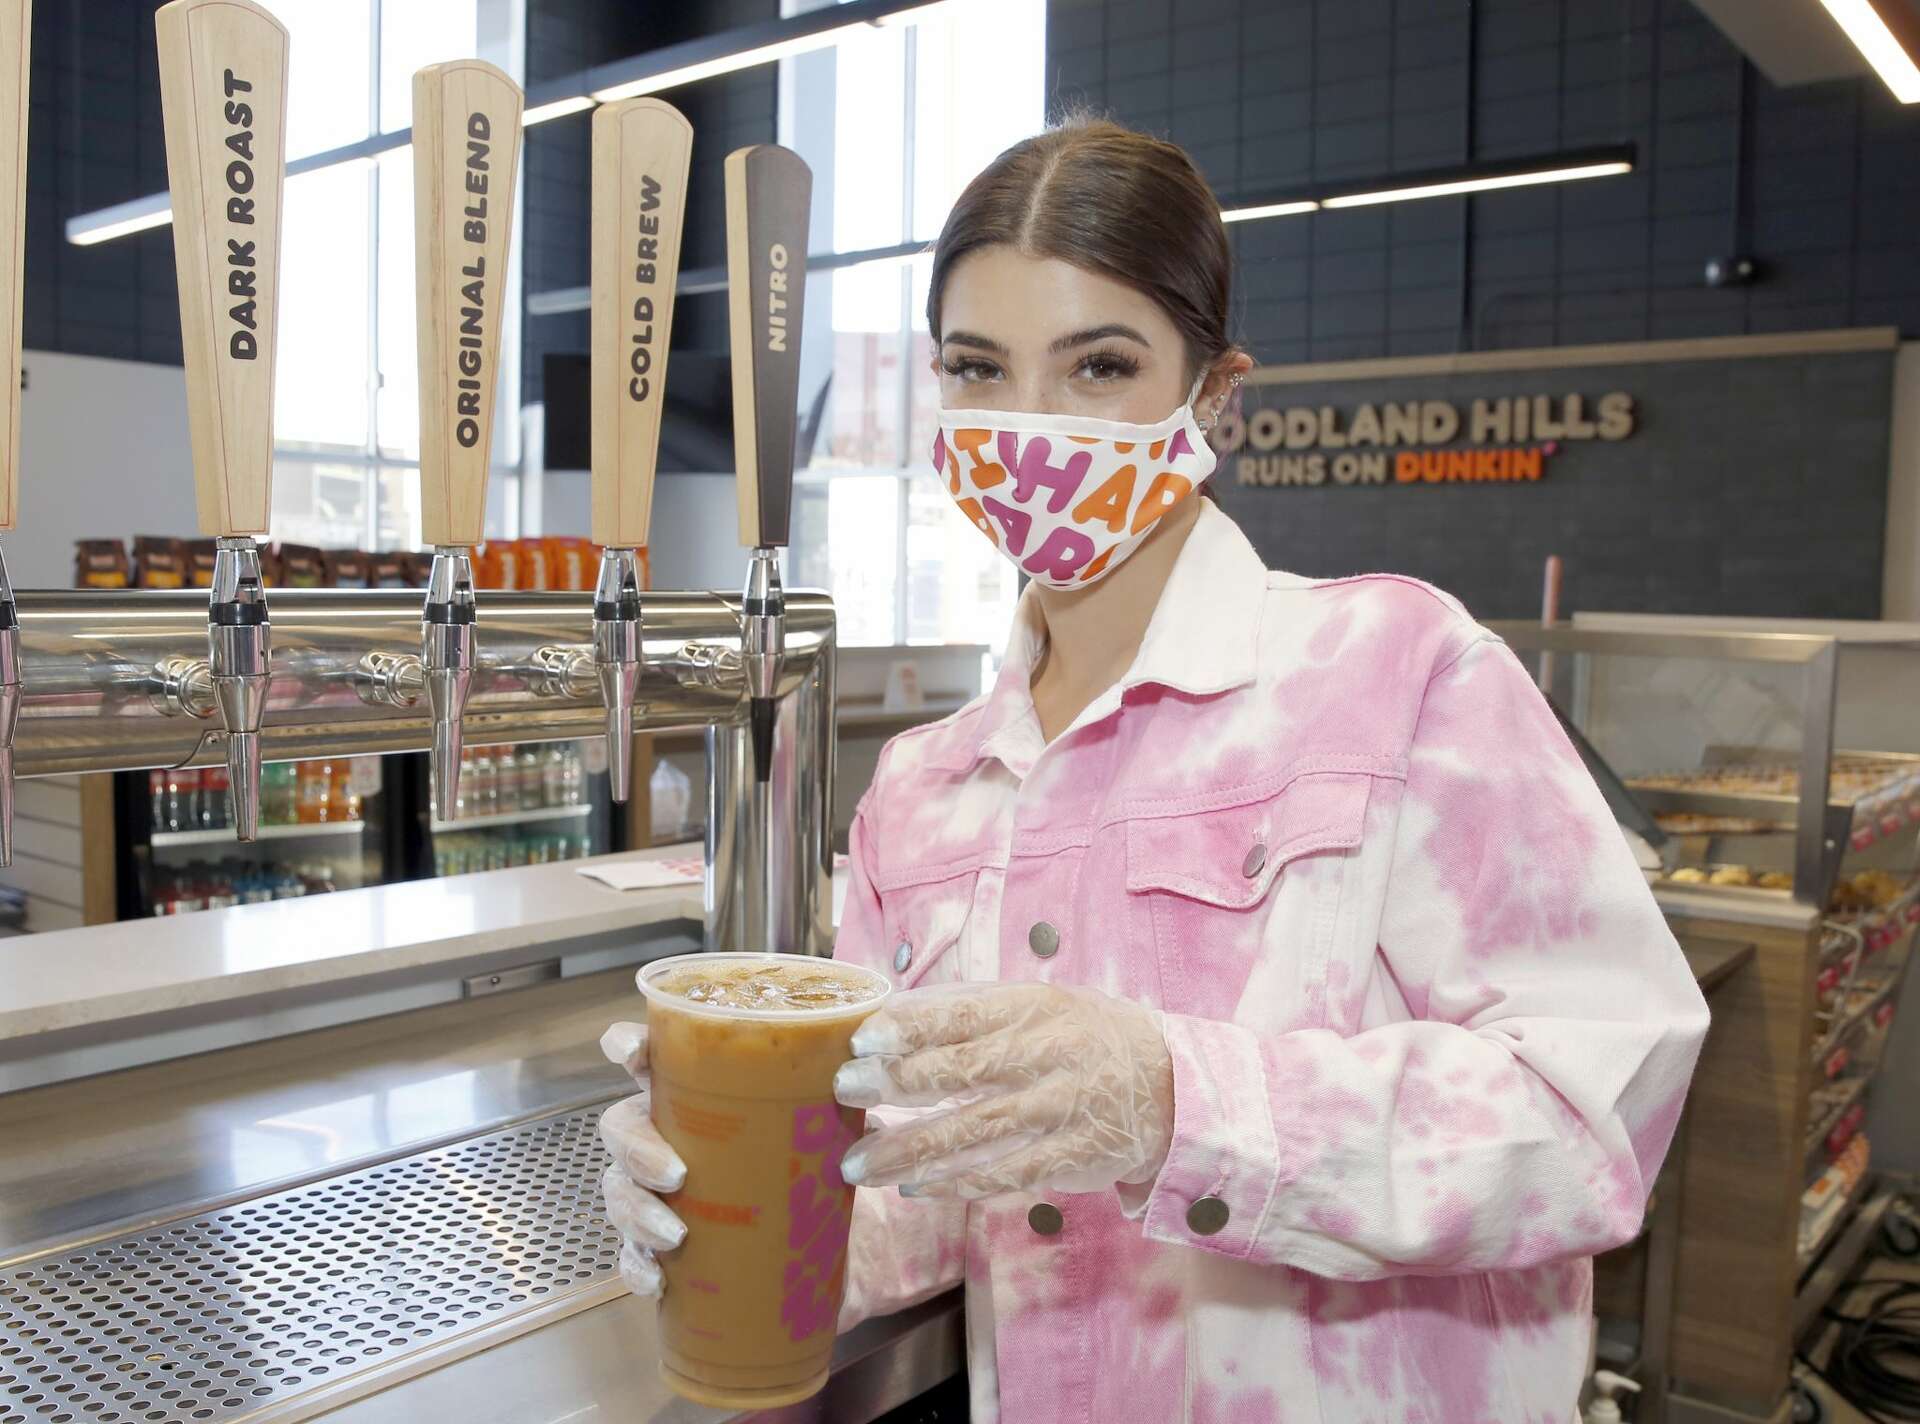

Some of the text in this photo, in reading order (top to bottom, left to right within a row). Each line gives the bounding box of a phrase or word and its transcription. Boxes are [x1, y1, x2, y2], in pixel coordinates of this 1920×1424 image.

[223, 68, 258, 361] DARK ROAST
[456, 111, 491, 449] ORIGINAL BLEND
[629, 175, 662, 402] COLD BREW
[768, 243, 790, 353] NITRO
[1212, 402, 1459, 451] OODLAND
[1472, 393, 1633, 442] HILLS
[1238, 442, 1555, 485] RUNS ON DUNKIN'
